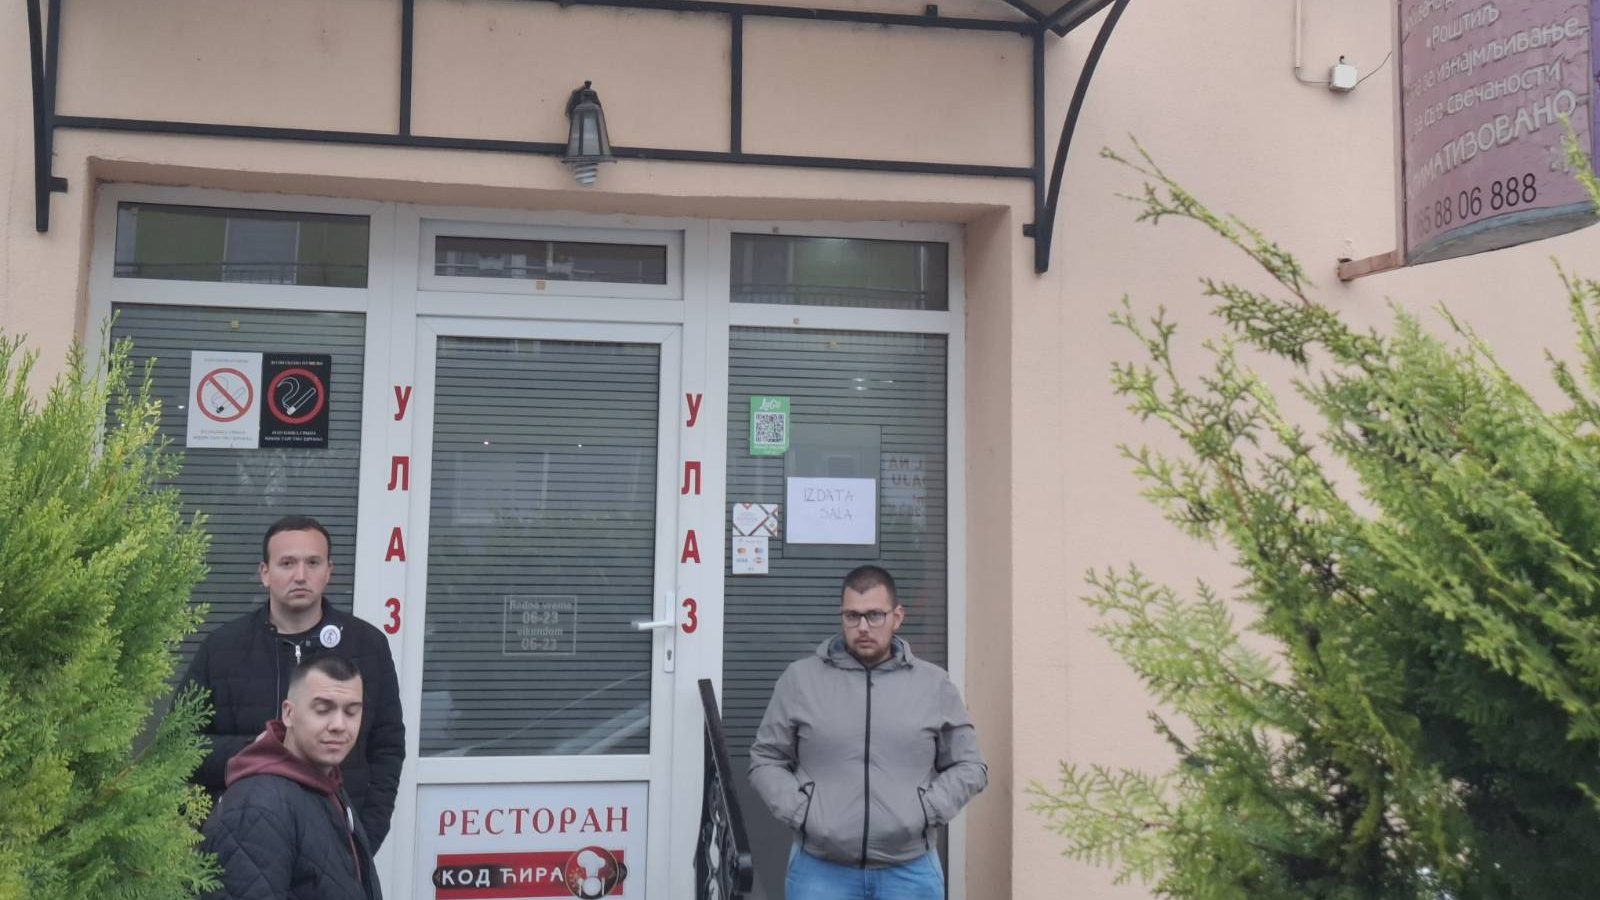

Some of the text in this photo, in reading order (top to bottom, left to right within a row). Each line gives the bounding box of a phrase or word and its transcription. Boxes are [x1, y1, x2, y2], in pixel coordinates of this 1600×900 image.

[1447, 60, 1561, 114] свечаности
[1434, 196, 1453, 229] 88
[1458, 186, 1483, 220] 06
[1490, 172, 1537, 211] 888
[803, 487, 855, 503] IZDATA
[818, 507, 853, 521] SALA
[522, 611, 559, 624] 06-23
[521, 637, 558, 650] 06-23
[437, 806, 629, 836] РЕСТОРАН
[442, 866, 565, 889] КОД ЋИРА
